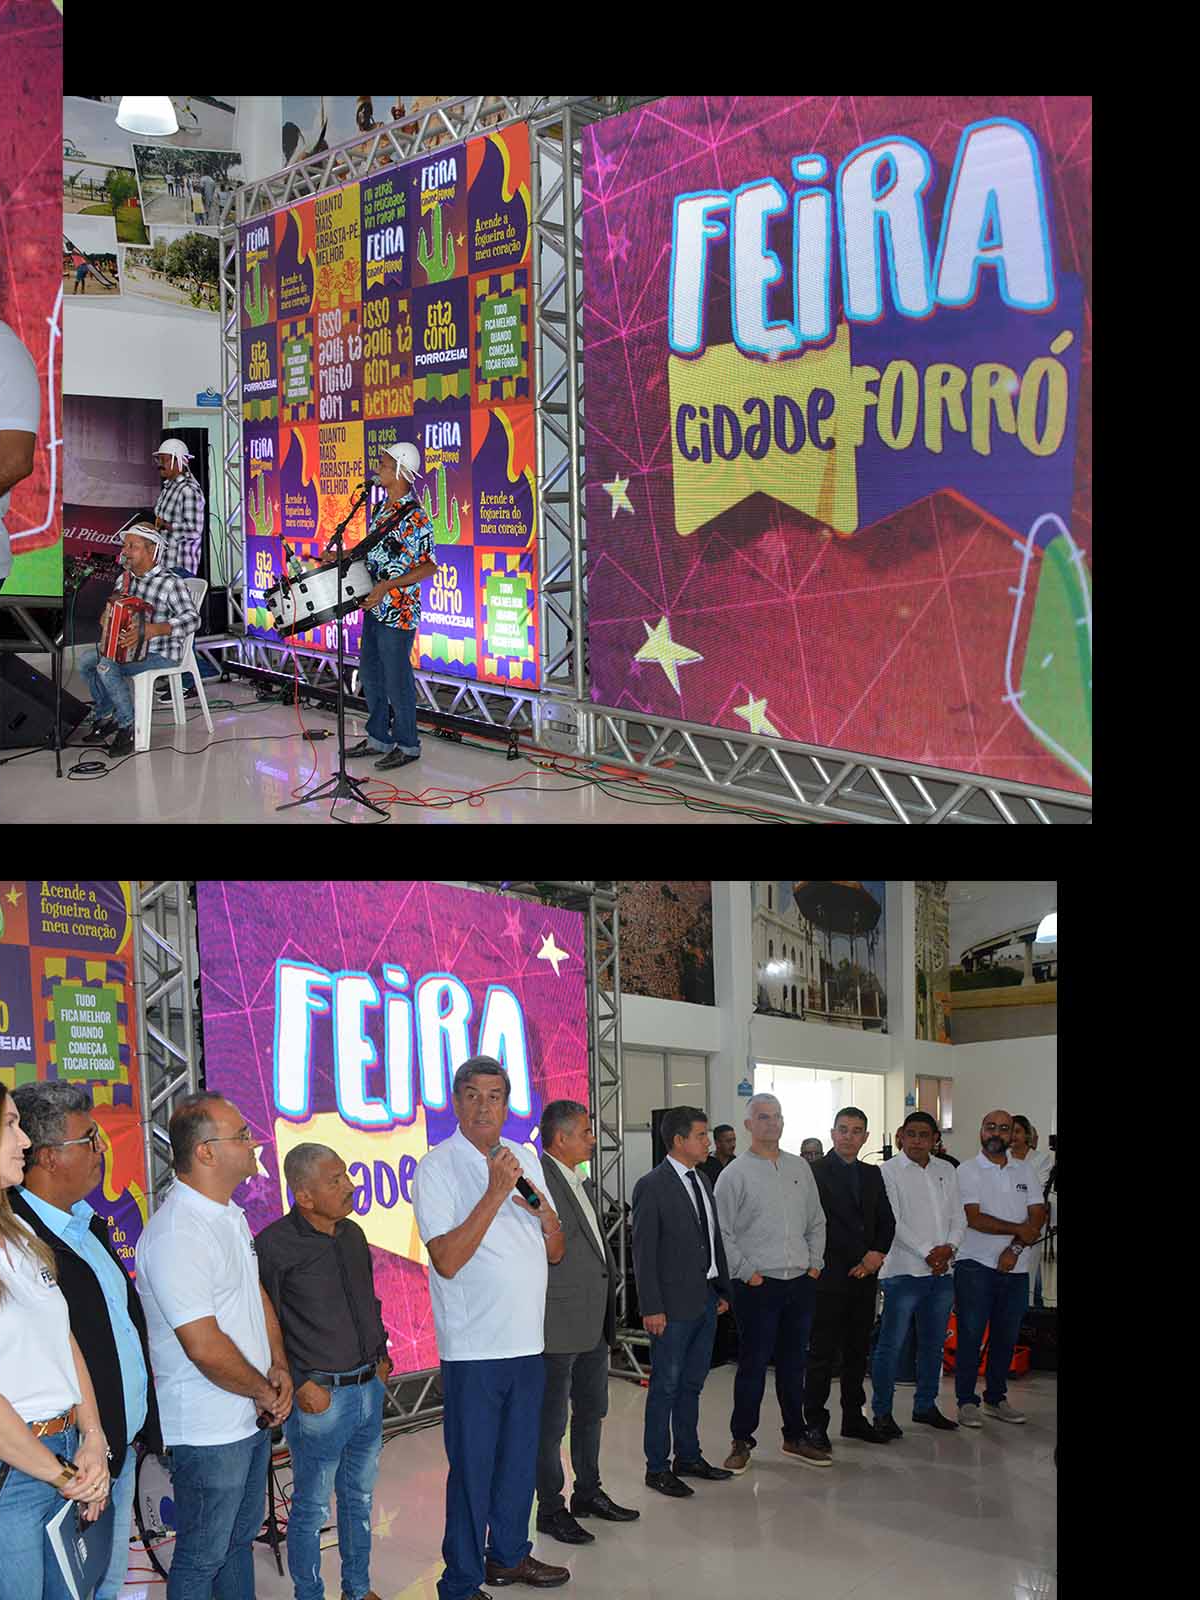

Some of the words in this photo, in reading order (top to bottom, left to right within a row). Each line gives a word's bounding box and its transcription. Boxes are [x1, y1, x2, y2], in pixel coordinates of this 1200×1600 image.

[475, 212, 502, 233] Acende
[506, 223, 517, 238] do
[415, 347, 468, 367] FORROZEIA!
[852, 329, 1075, 456] FORRÓ
[480, 490, 508, 505] Acende
[480, 505, 511, 522] fogueira
[512, 503, 522, 519] do
[480, 523, 497, 535] meu
[498, 519, 528, 537] coração
[420, 611, 474, 629] FORROZEIA!
[40, 881, 86, 901] Acende
[88, 890, 97, 903] a
[41, 897, 92, 919] fogueira
[93, 903, 108, 921] do
[41, 920, 69, 935] meu
[72, 922, 117, 941] coração
[74, 993, 97, 1008] TUDO
[60, 1008, 80, 1023] FICA
[79, 1010, 112, 1025] MELHOR
[70, 1025, 104, 1040] QUANDO
[68, 1042, 99, 1056] COMEÇA
[98, 1044, 108, 1056] A
[63, 1056, 89, 1070] TOCAR
[89, 1057, 116, 1072] FORRÓ
